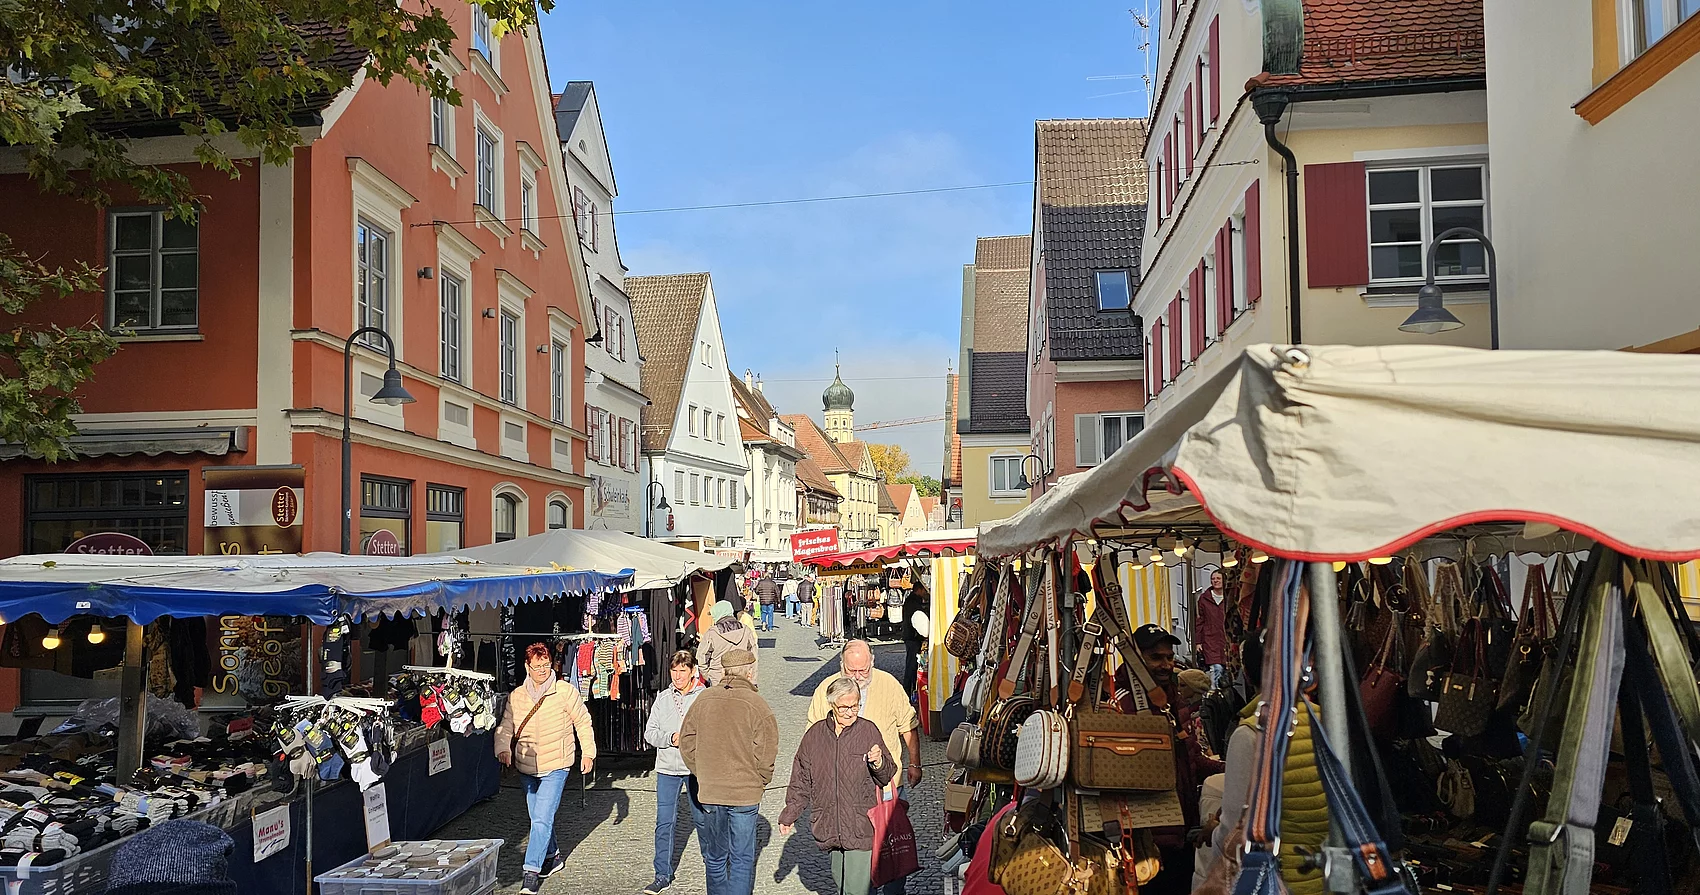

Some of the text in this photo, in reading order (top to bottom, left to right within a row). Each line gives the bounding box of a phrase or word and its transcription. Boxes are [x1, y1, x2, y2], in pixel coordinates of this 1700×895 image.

[210, 490, 219, 526] bewusst
[276, 492, 285, 522] Stetter
[372, 539, 397, 554] Stetter
[798, 536, 831, 547] frisches
[77, 544, 144, 555] Stetter
[794, 544, 838, 555] Magenbrot
[821, 562, 879, 572] Zuckerwatte
[258, 820, 284, 837] Manu's
